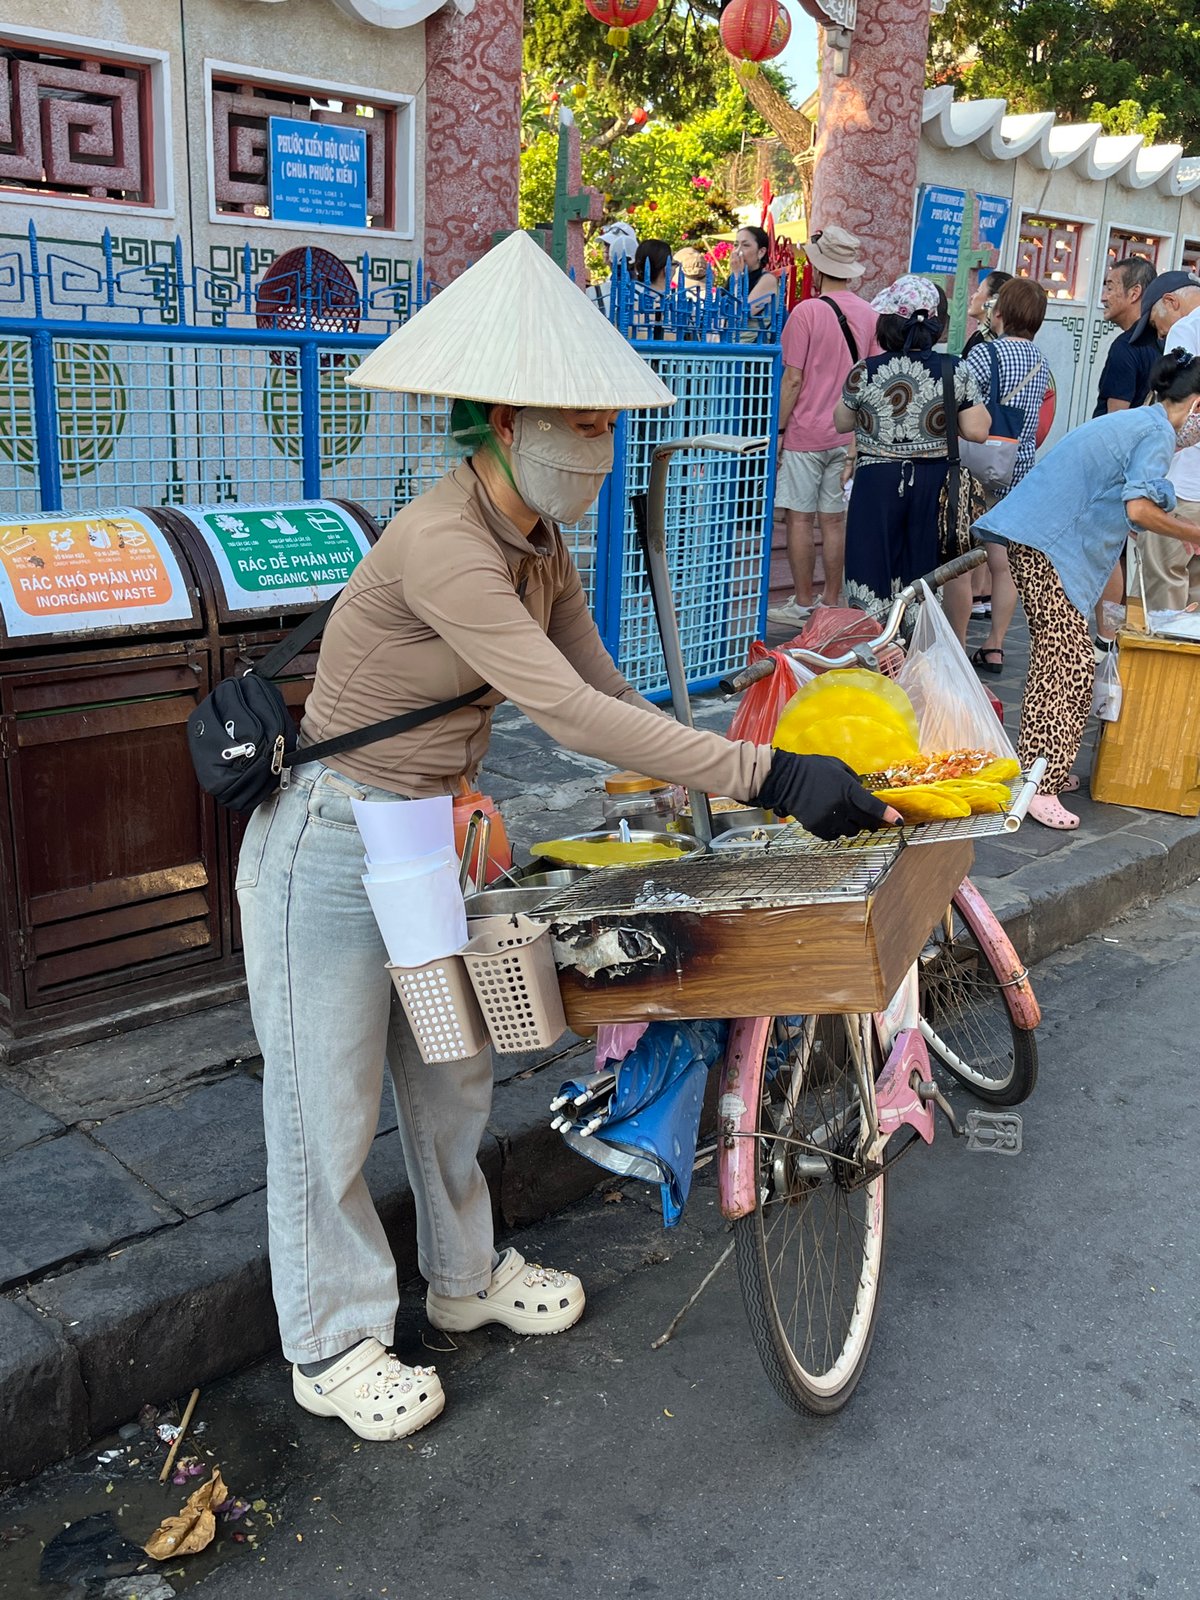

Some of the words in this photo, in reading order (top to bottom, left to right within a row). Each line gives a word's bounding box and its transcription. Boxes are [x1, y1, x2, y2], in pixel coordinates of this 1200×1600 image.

[304, 132, 323, 158] KIẾN
[324, 137, 338, 164] HỘI
[339, 140, 360, 164] QUÁN
[237, 556, 267, 572] RÁC
[269, 551, 289, 569] DỄ
[291, 551, 328, 568] PHÂN
[329, 547, 355, 564] HUỶ
[19, 574, 52, 591] RÁC
[54, 570, 87, 589] KHÓ
[89, 568, 129, 586] PHÂN
[131, 563, 158, 582] HUỶ
[258, 571, 309, 586] ORGANIC
[311, 568, 349, 581] WASTE
[36, 590, 110, 608] INORGANIC
[112, 586, 156, 601] WASTE
